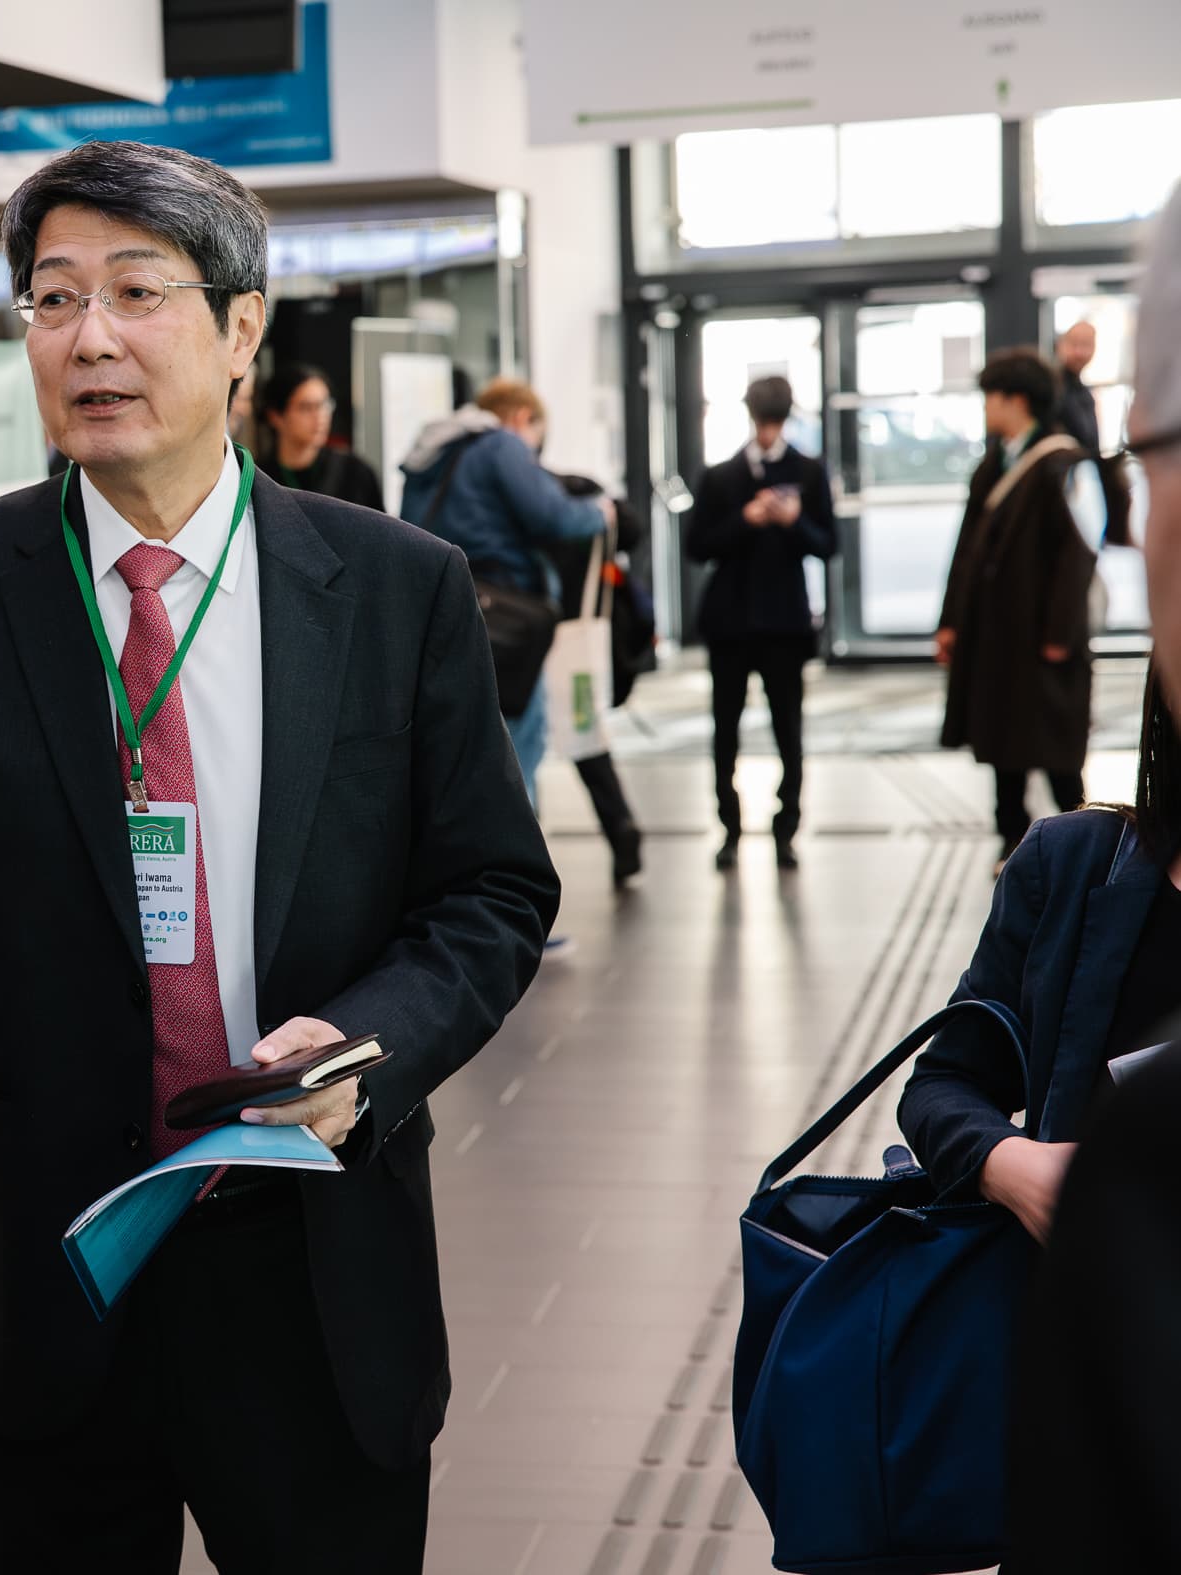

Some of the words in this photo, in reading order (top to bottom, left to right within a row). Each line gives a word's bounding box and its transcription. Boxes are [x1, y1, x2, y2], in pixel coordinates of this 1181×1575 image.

[130, 834, 176, 851] RERA
[145, 873, 172, 883] Iwama
[137, 885, 153, 893] apan
[161, 884, 183, 893] Austria
